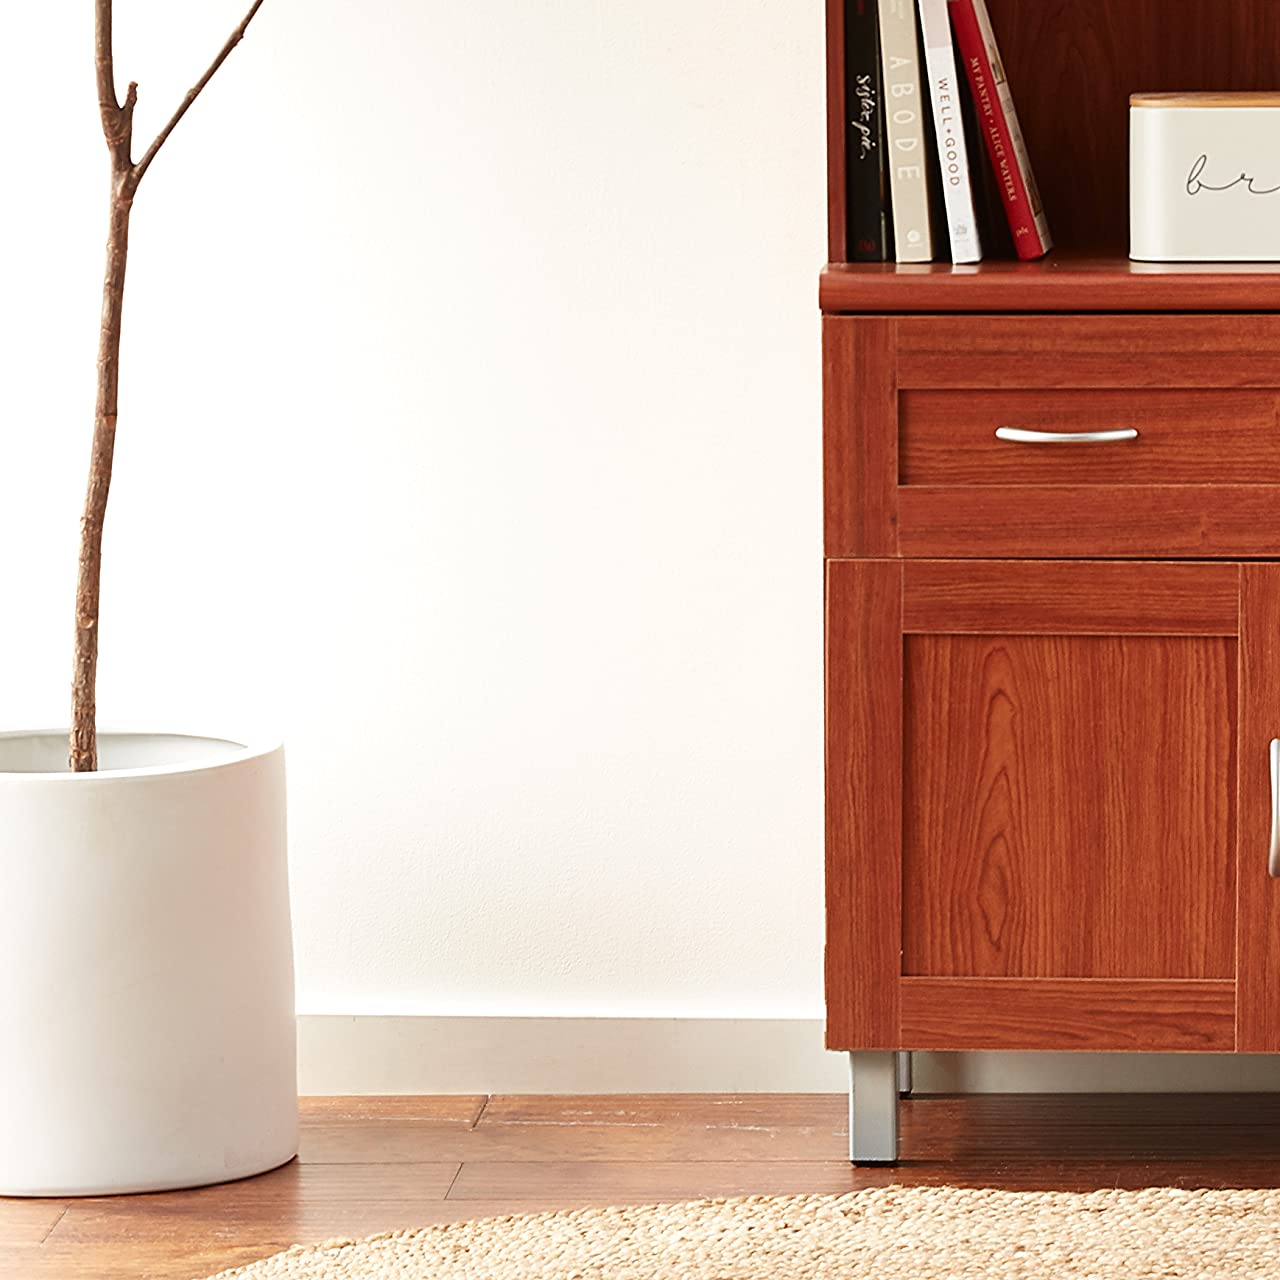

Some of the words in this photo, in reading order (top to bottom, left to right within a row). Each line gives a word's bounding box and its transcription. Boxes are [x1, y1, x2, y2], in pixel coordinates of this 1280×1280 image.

[970, 56, 983, 75] MY
[975, 75, 993, 117] PANTRY
[889, 56, 920, 180] ABODE
[989, 126, 1005, 158] ALICE
[999, 158, 1018, 202] WATERS
